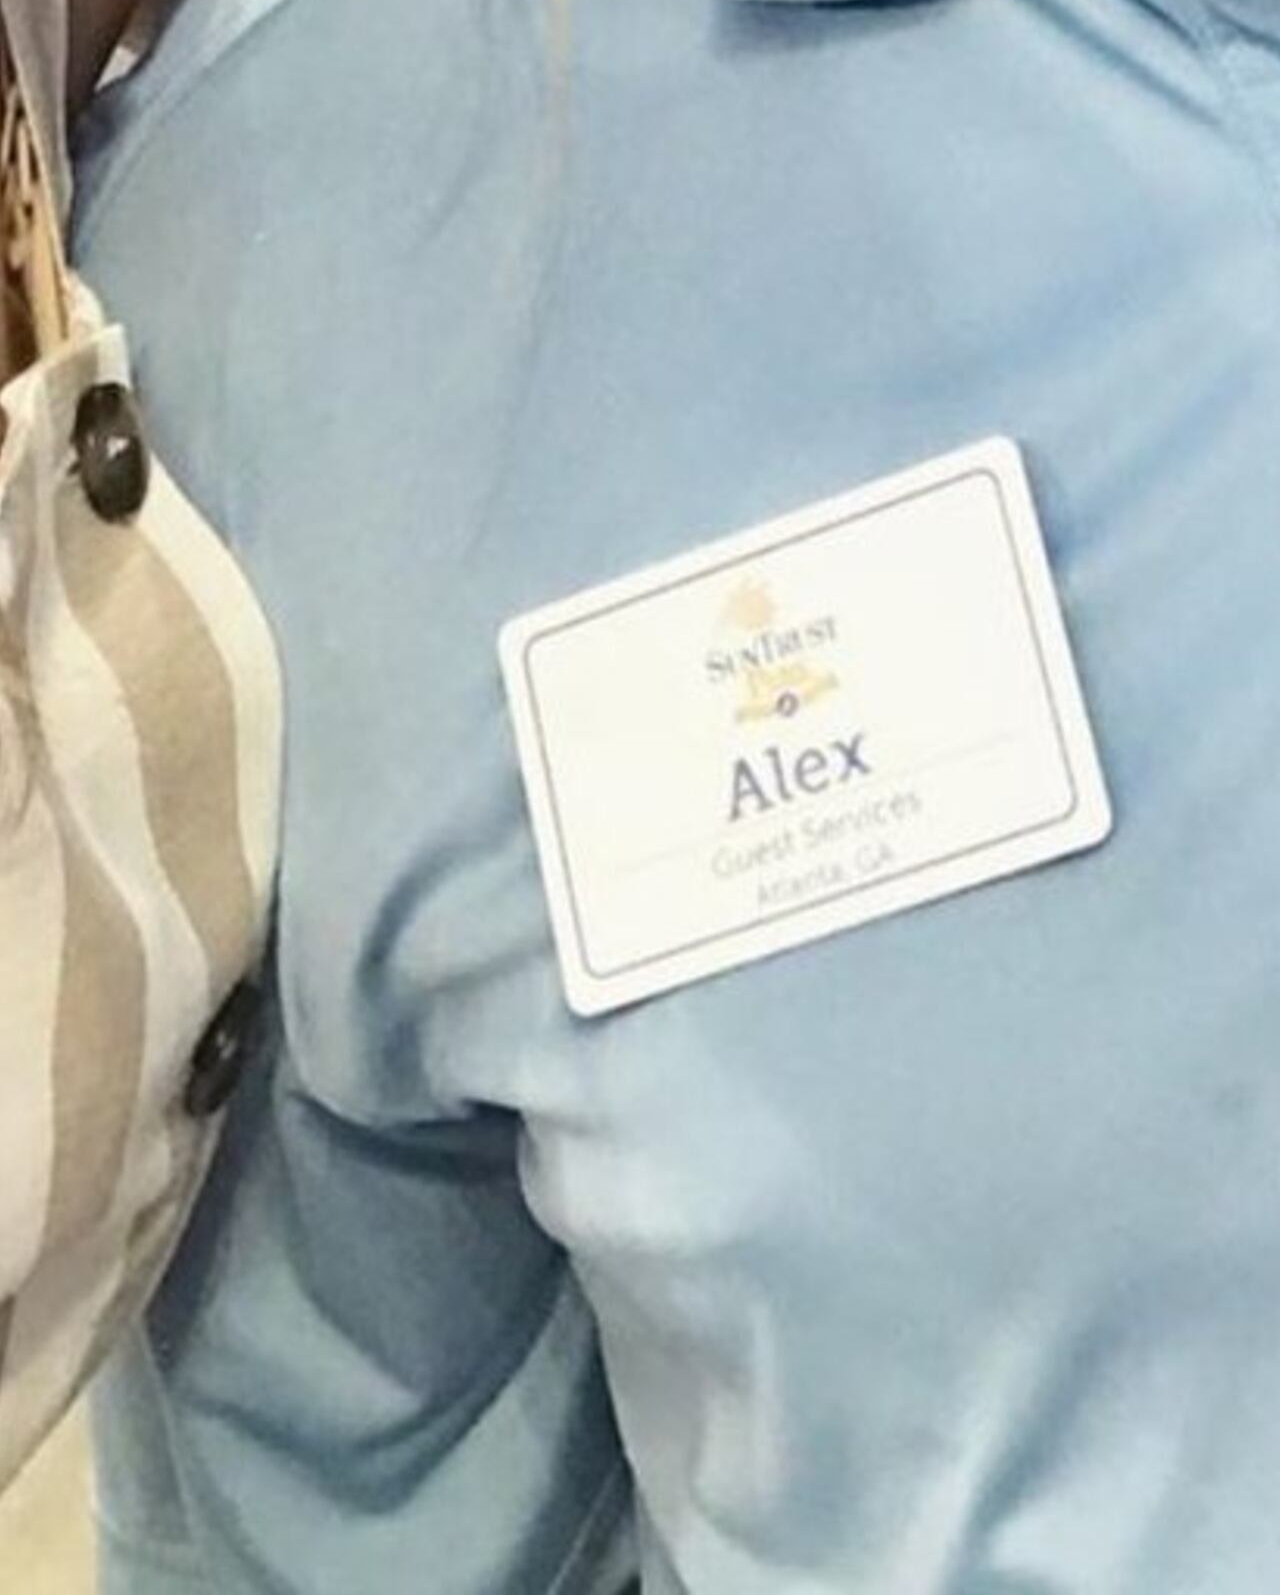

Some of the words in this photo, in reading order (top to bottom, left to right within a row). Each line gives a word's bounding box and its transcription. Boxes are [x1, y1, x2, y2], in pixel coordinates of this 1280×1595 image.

[728, 733, 872, 822] Alex
[711, 830, 795, 878] Guest
[801, 792, 922, 850] Services
